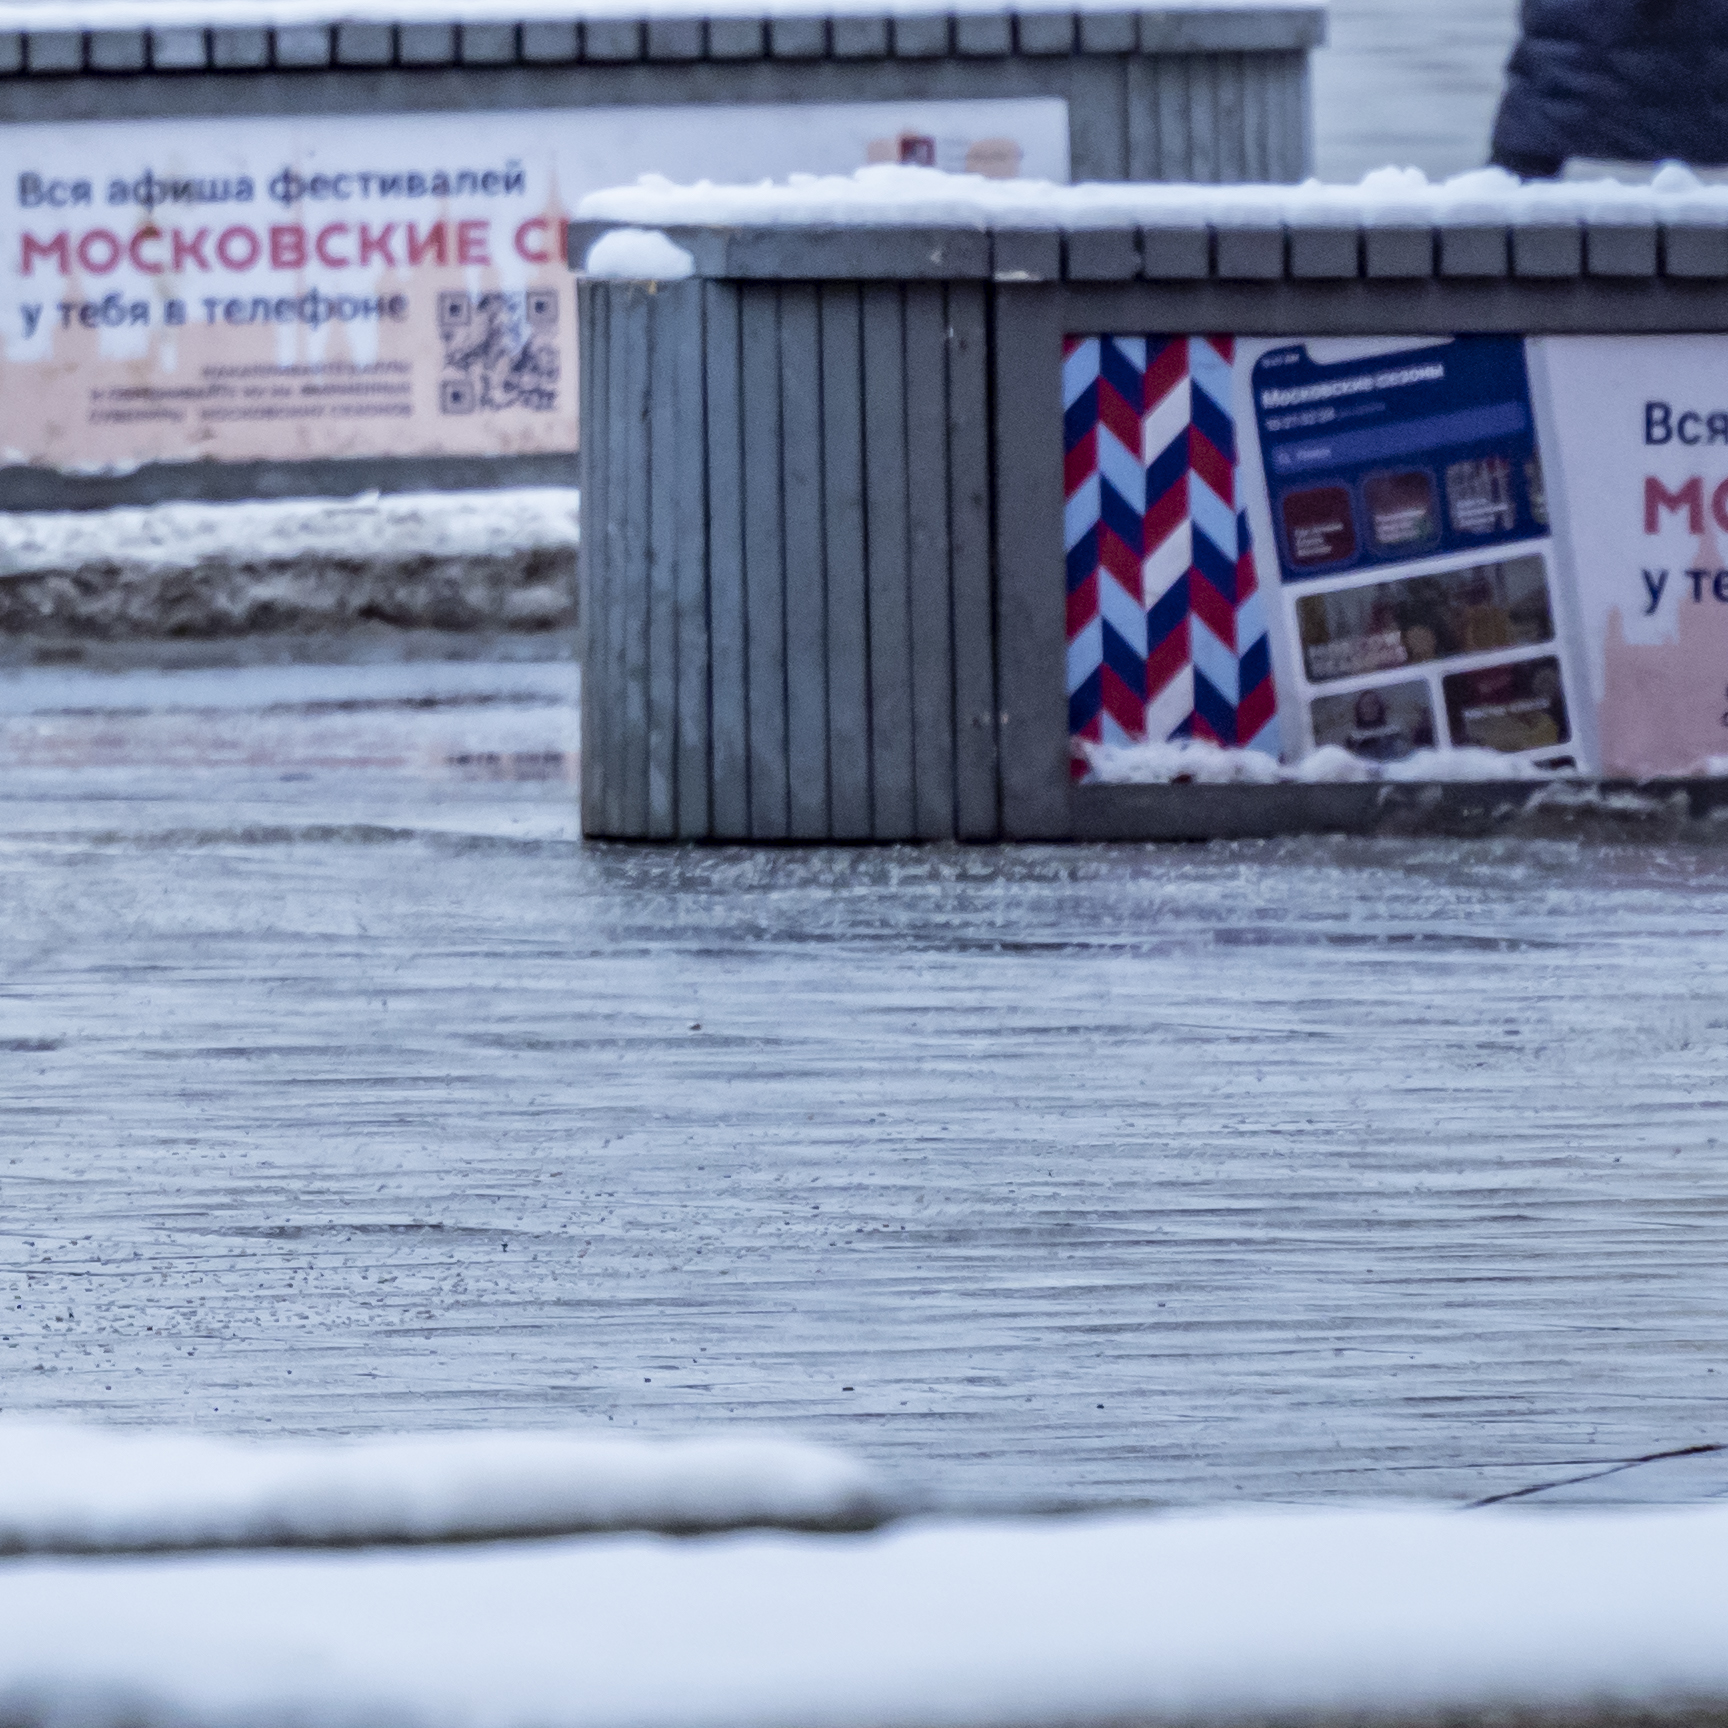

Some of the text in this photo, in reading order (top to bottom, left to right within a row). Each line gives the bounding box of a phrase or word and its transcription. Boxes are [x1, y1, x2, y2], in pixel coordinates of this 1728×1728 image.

[19, 158, 525, 211] Вся афиша фестивалей
[20, 215, 568, 275] МОСКОВСКИЕ С
[20, 287, 407, 339] у тебя в телефоне
[1643, 399, 1728, 446] Вся
[1641, 567, 1670, 617] у
